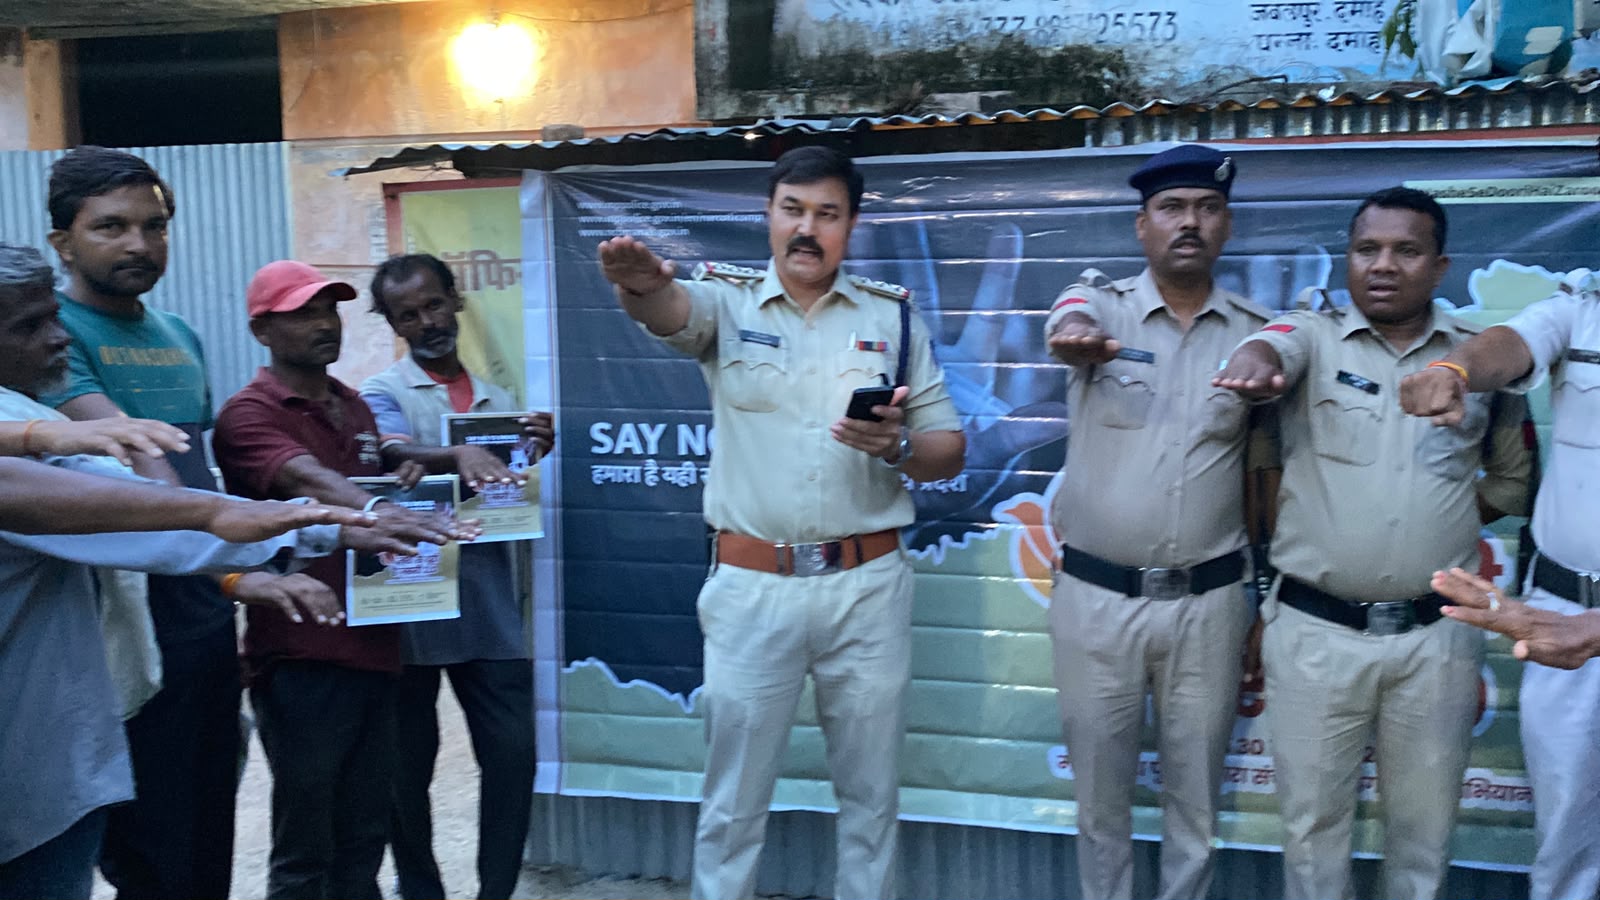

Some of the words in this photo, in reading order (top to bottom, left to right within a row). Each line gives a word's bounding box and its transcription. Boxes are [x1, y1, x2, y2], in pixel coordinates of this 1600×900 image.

[589, 422, 667, 456] SAY
[591, 465, 642, 485] हमारा
[643, 459, 663, 487] है
[664, 461, 699, 487] यही
